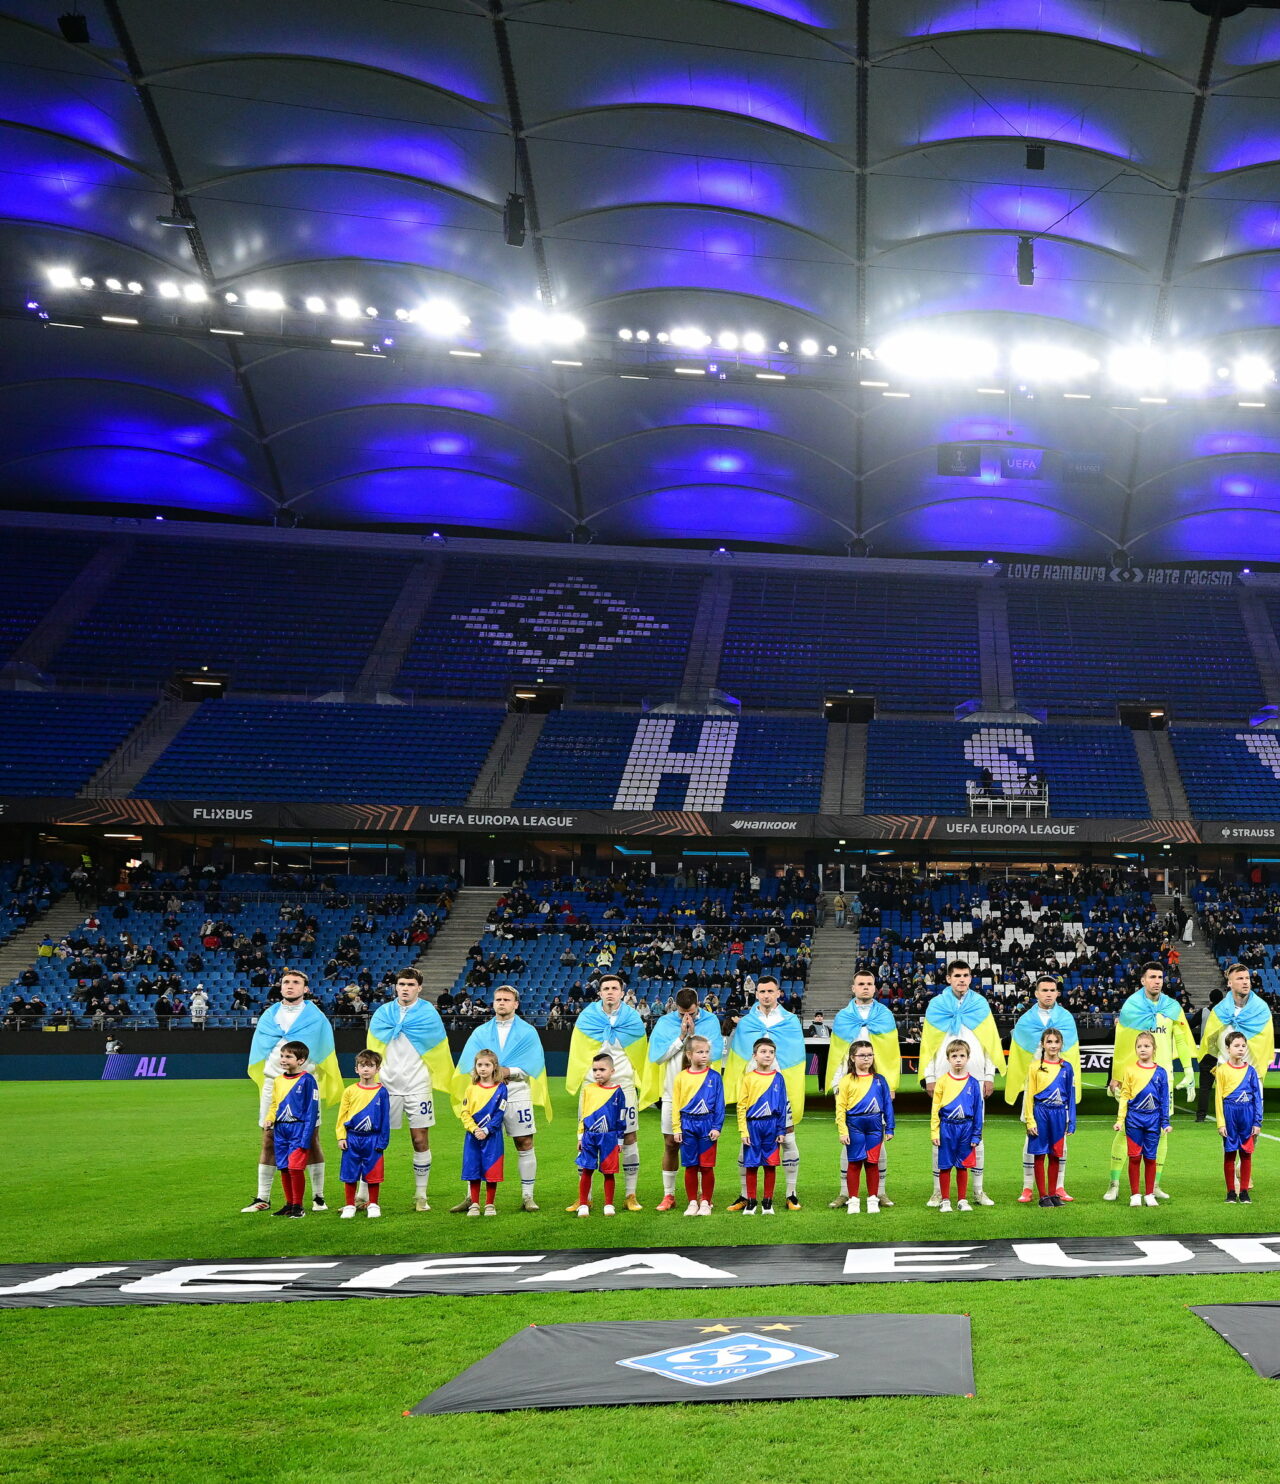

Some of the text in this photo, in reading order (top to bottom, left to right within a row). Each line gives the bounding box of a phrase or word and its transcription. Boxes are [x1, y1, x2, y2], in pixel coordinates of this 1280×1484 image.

[1007, 458, 1037, 470] UEFA
[612, 718, 738, 811] H
[429, 814, 574, 827] UEFA EUROPA LEAGUE
[946, 823, 1076, 835] UEFA EUROPA LEAGUE
[1232, 828, 1275, 837] STRAUSS
[134, 1056, 167, 1077] ALL
[419, 1100, 433, 1115] 32
[517, 1108, 532, 1124] 15
